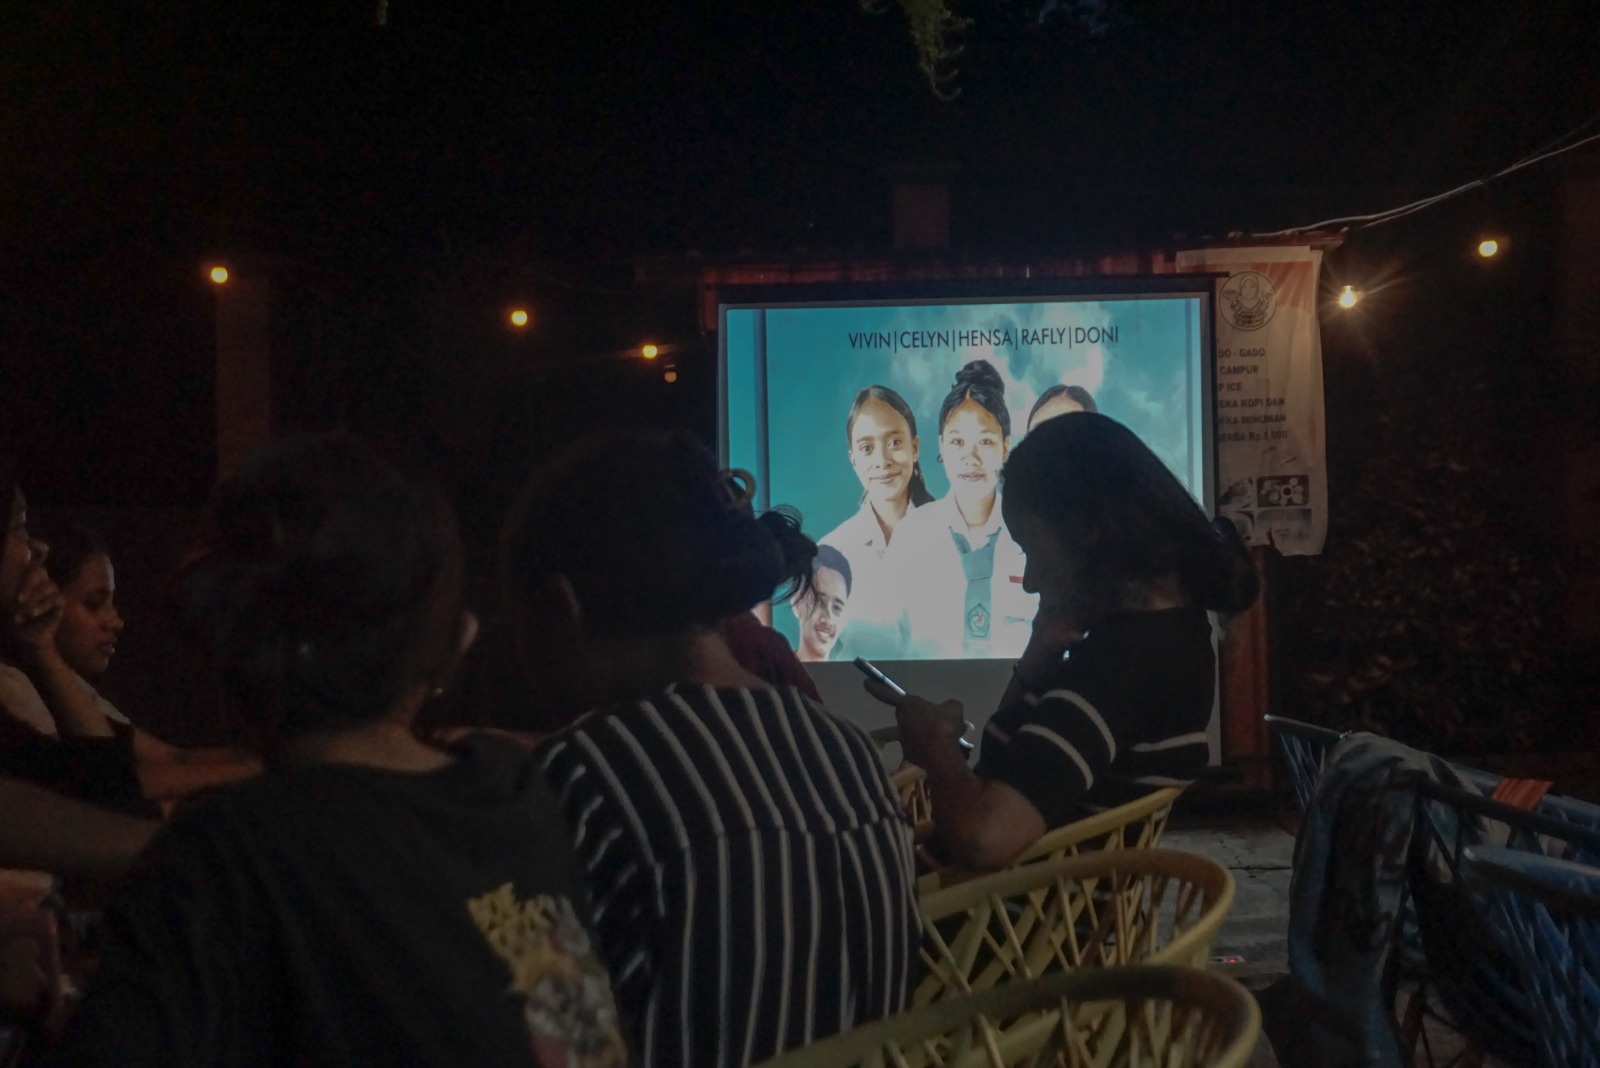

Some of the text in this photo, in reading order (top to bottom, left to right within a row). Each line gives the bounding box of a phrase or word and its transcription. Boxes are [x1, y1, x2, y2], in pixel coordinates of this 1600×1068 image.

[1239, 348, 1265, 357] GADO
[1220, 365, 1259, 375] CAMPUR
[1241, 398, 1264, 407] KOPI
